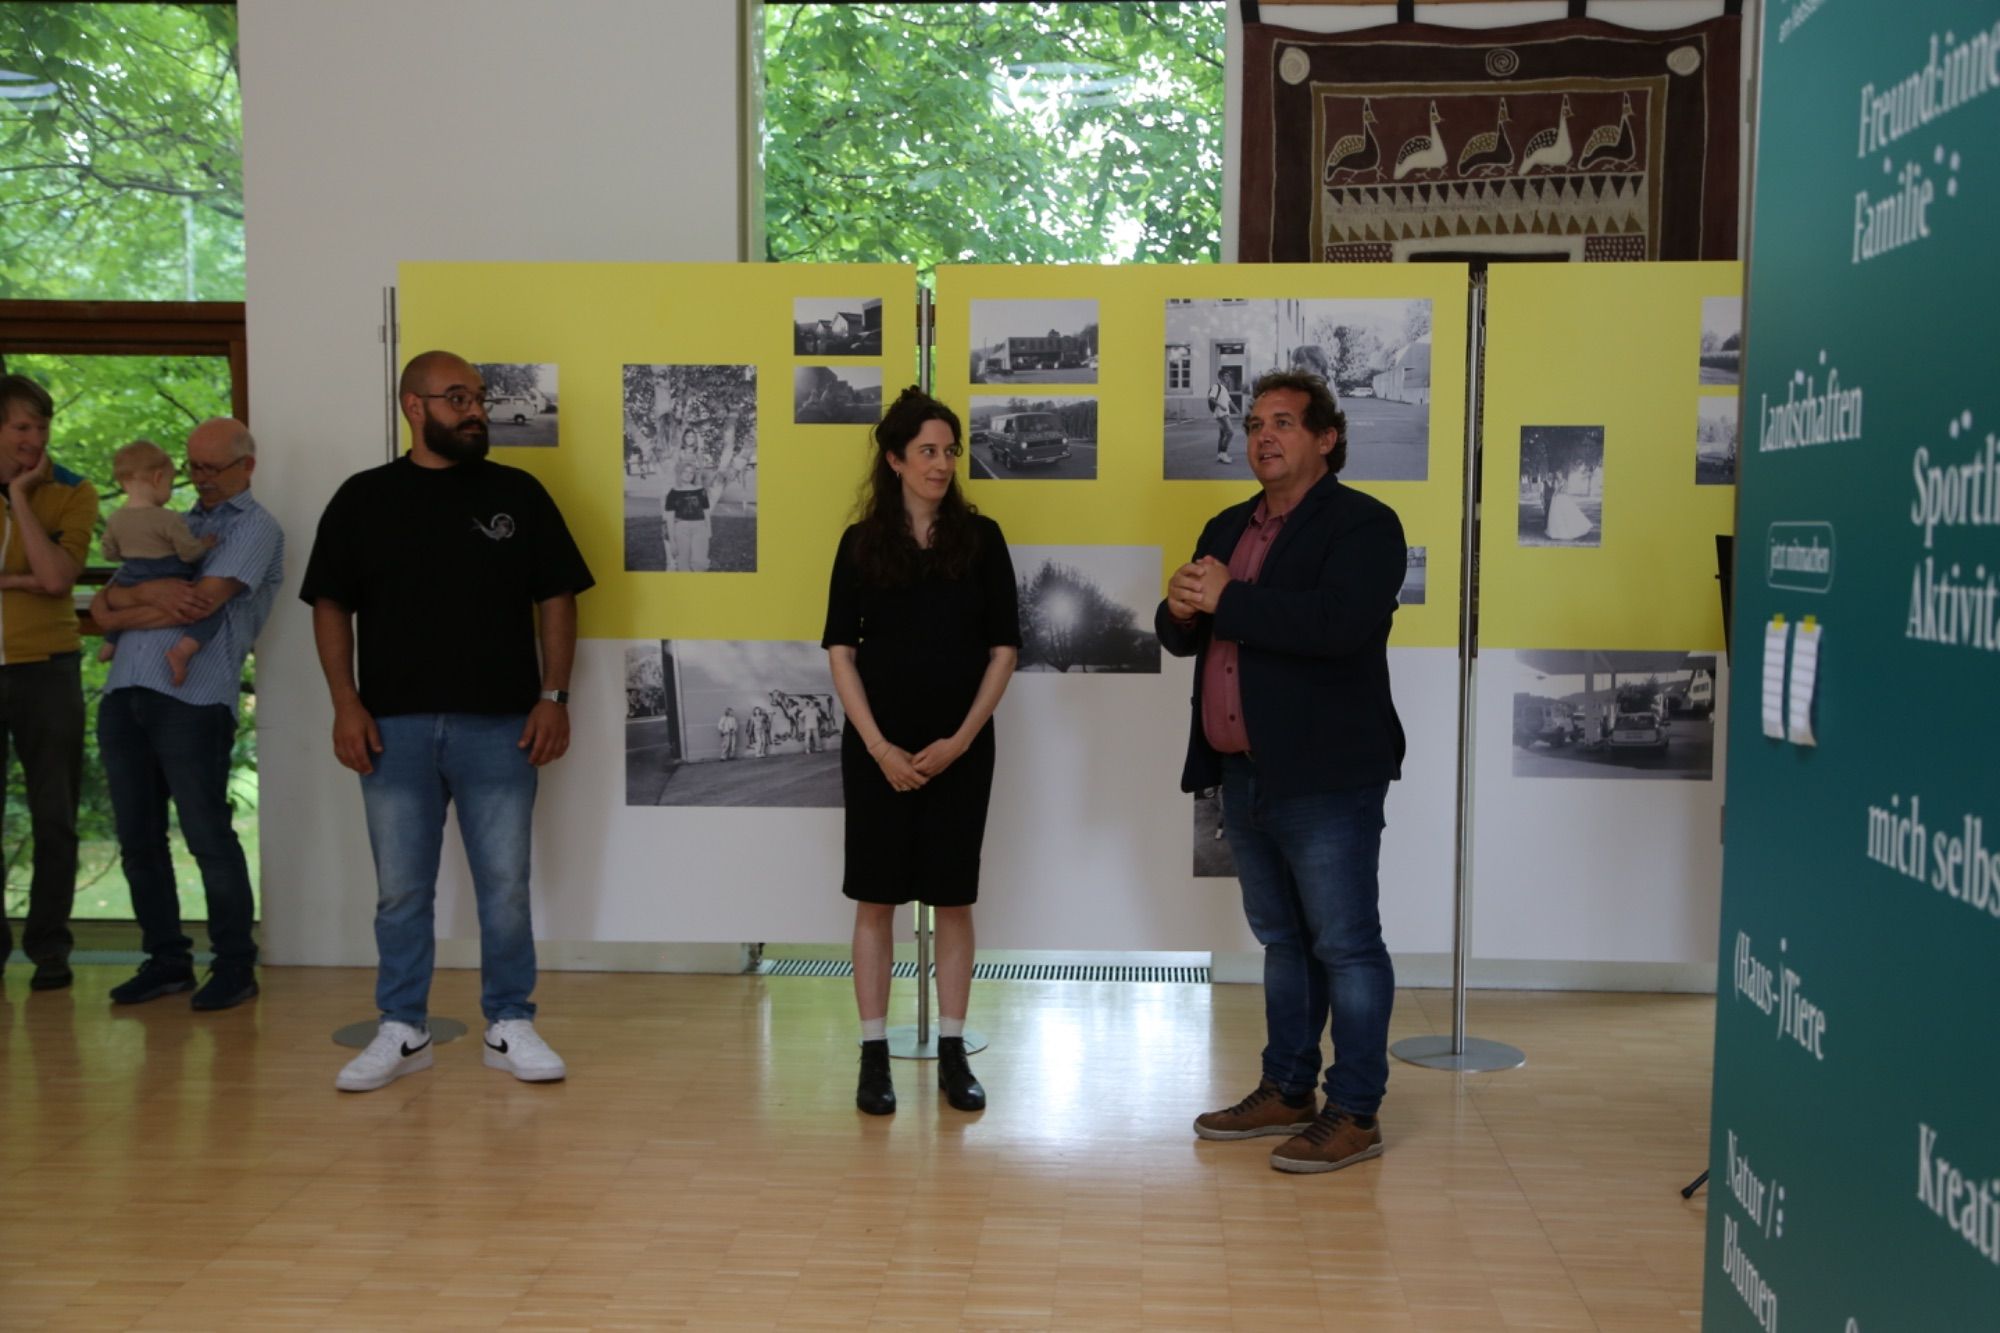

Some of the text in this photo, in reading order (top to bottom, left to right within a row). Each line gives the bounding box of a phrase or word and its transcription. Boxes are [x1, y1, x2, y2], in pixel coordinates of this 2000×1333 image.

[1852, 161, 1935, 264] Familie
[1759, 367, 1863, 452] Landschaften
[1866, 793, 1926, 882] mich
[1725, 1128, 1765, 1228] Natur
[1722, 1213, 1777, 1333] Blumen
